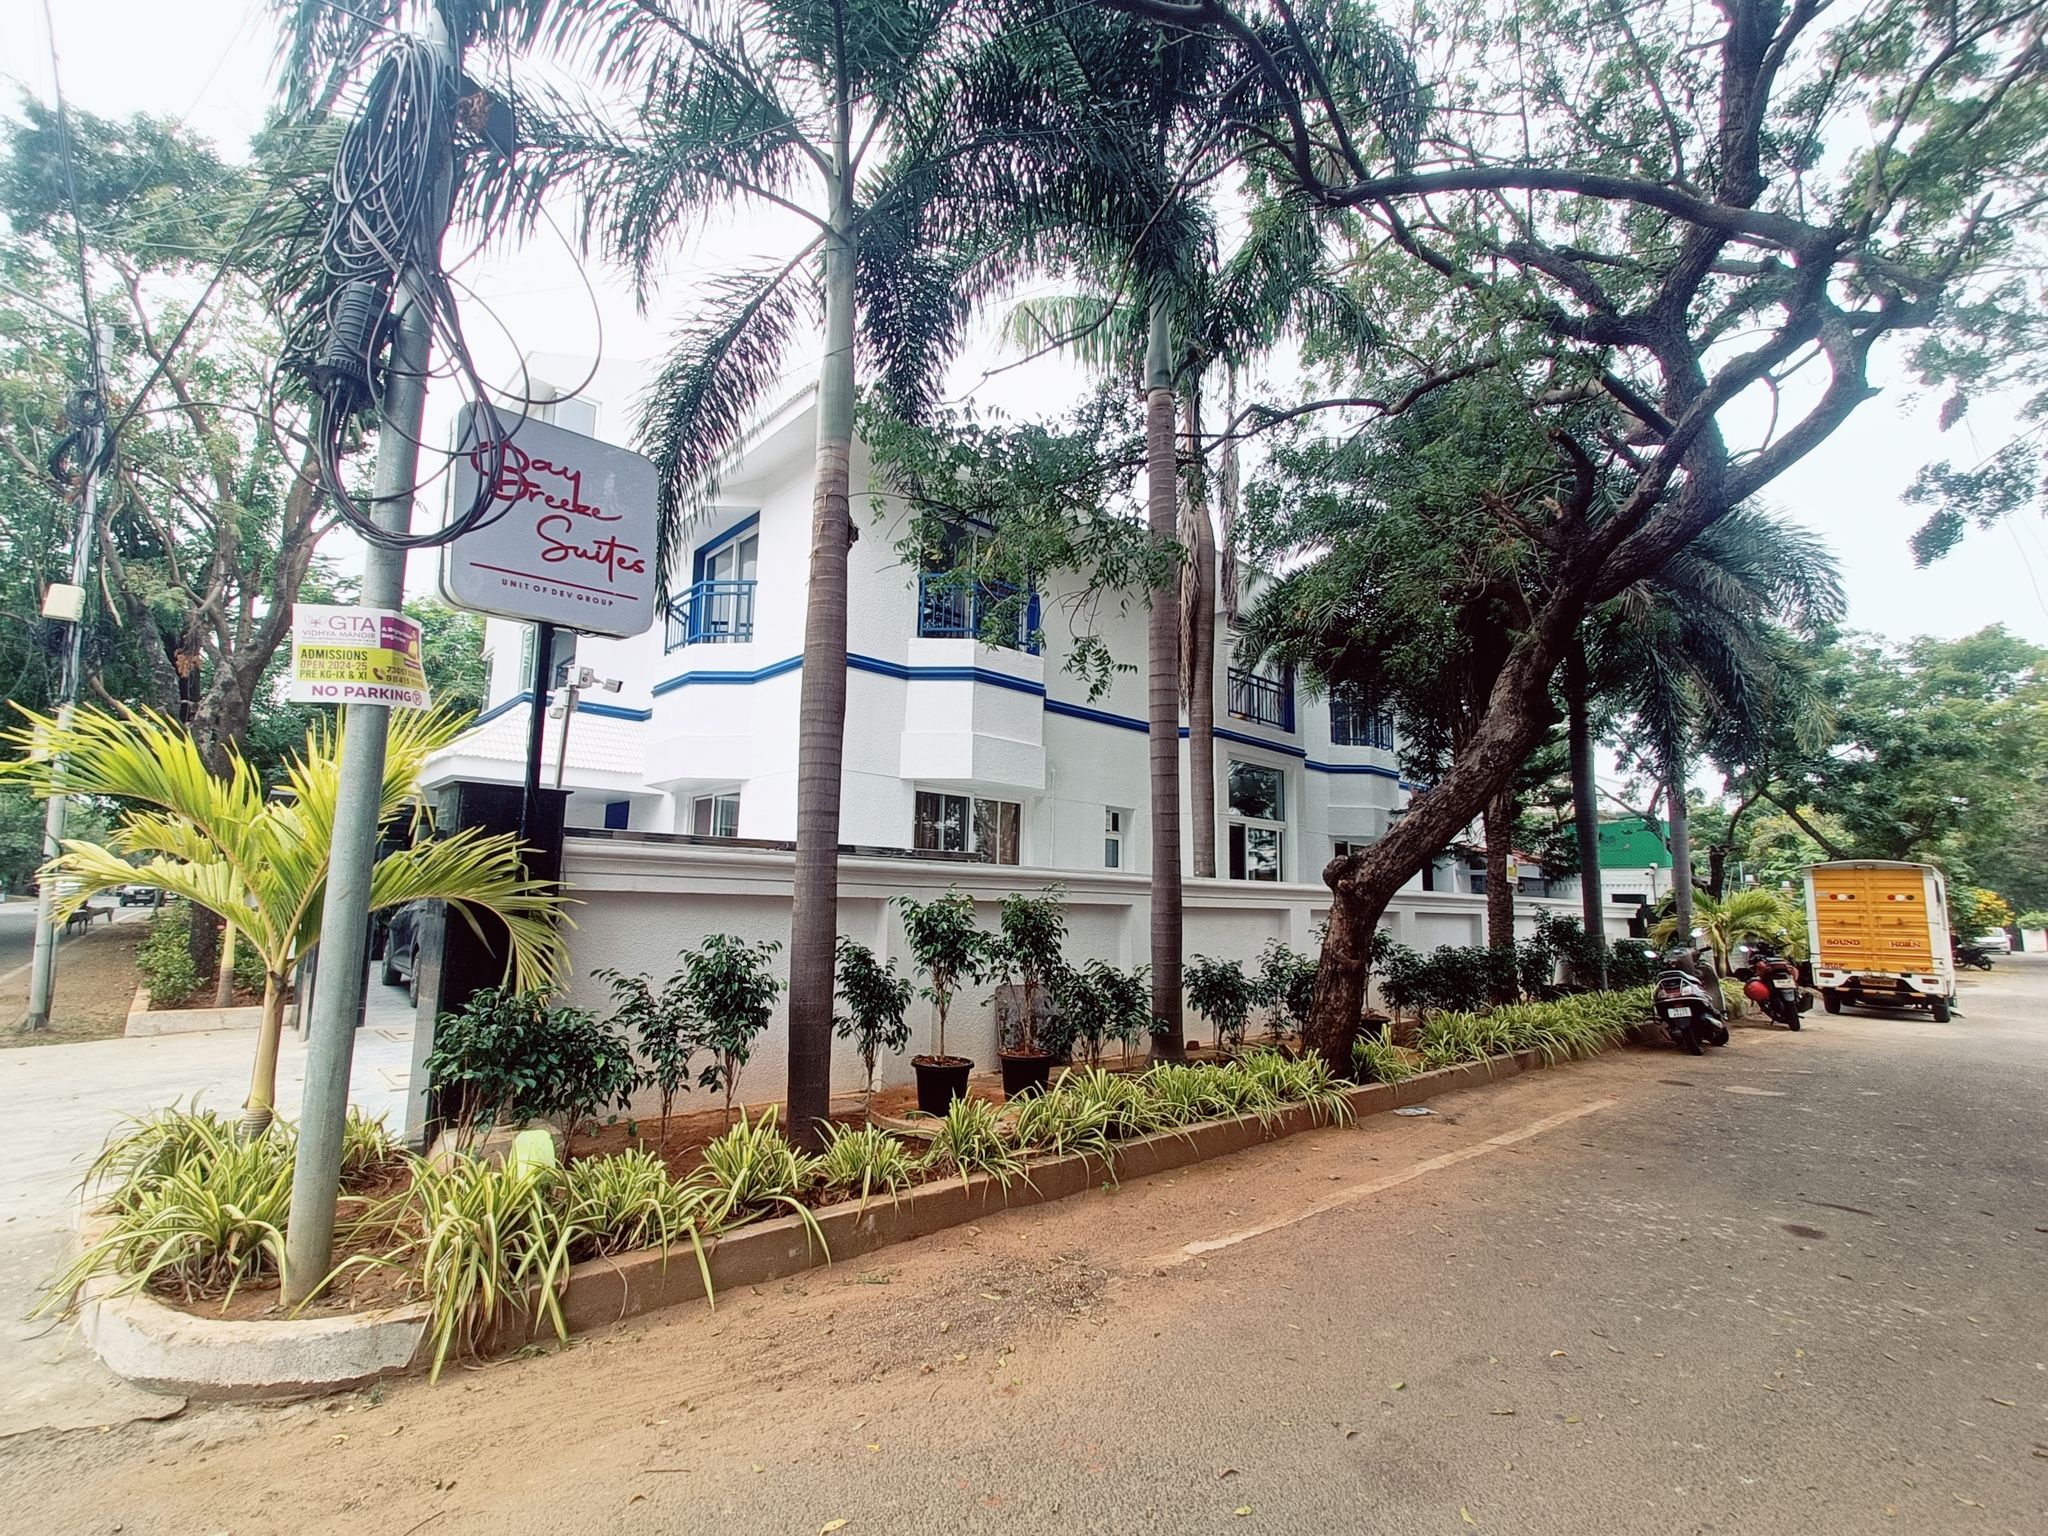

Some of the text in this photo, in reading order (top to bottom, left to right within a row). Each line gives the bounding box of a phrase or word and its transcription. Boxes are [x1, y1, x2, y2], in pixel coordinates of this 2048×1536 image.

[536, 515, 645, 583] Suites
[501, 578, 614, 606] UNIT OF DEV GROUP
[328, 616, 376, 632] GTA
[302, 629, 336, 637] VIDHYA
[339, 631, 376, 639] MANDIR
[301, 649, 368, 661] ADMISSIONS
[300, 660, 368, 670] OPEN 2024-25
[300, 670, 368, 680] PRE KG-IX & XI
[312, 685, 412, 702] NO PARKING
[1826, 938, 1861, 946] SOUND
[1891, 940, 1921, 948] HORN
